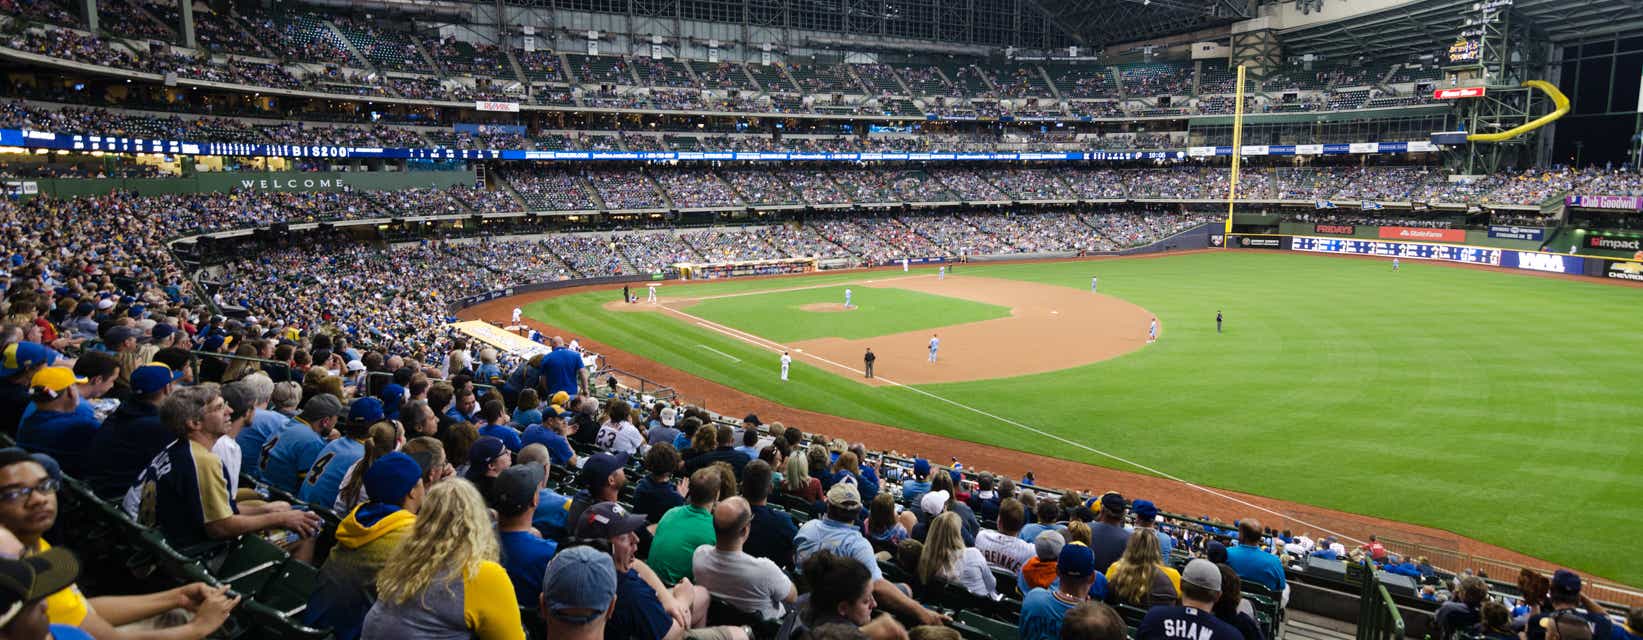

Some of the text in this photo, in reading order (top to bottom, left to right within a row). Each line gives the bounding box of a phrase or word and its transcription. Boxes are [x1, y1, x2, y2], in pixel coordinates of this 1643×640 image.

[241, 180, 344, 189] WELCOME
[1582, 196, 1637, 209] Club Goodwill
[307, 451, 336, 485] 4
[980, 549, 1021, 574] REINKE
[1163, 618, 1214, 640] SHAW
